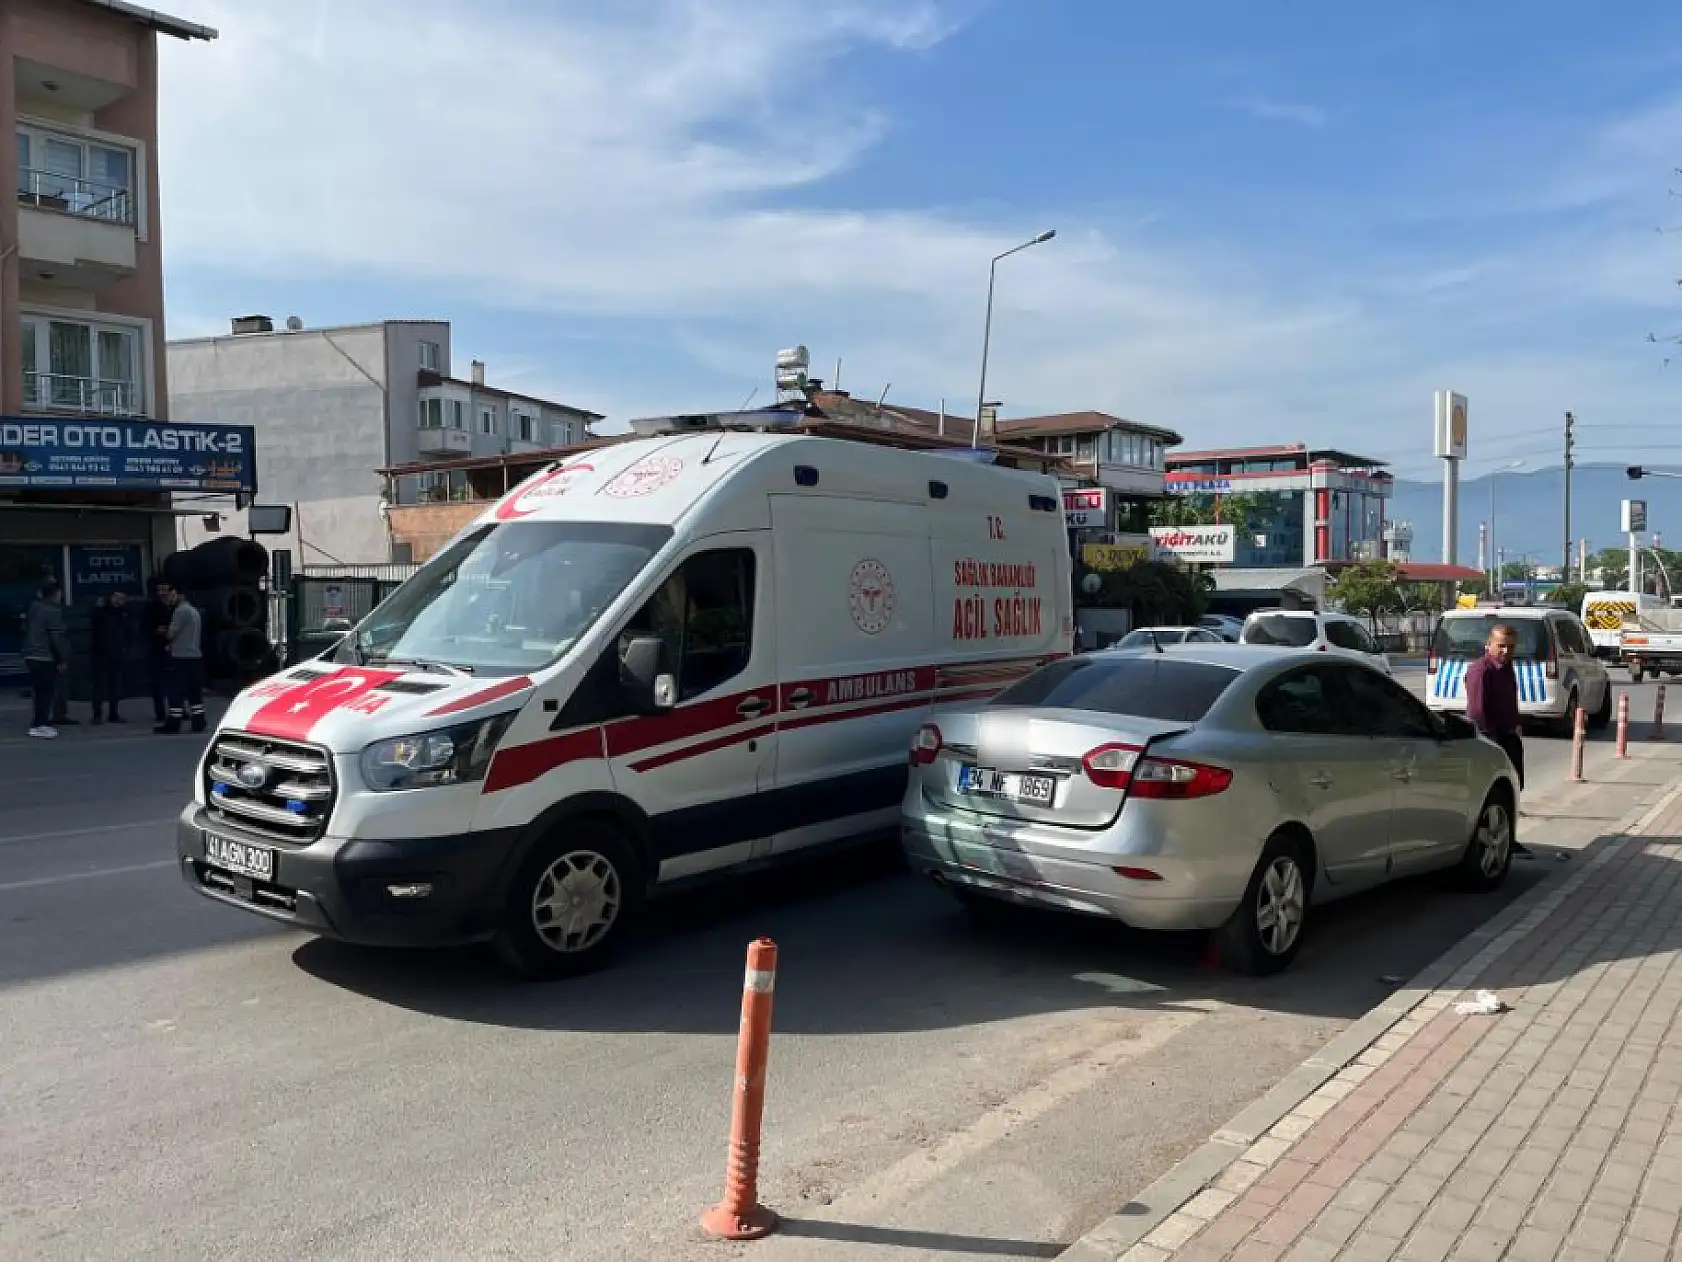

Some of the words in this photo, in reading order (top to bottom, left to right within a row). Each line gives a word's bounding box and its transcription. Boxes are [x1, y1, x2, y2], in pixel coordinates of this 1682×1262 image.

[64, 426, 121, 448] OTO
[89, 556, 124, 568] OTO
[953, 592, 988, 640] ACİL
[994, 589, 1041, 637] SAĞLIK
[827, 671, 916, 701] AMBULANS
